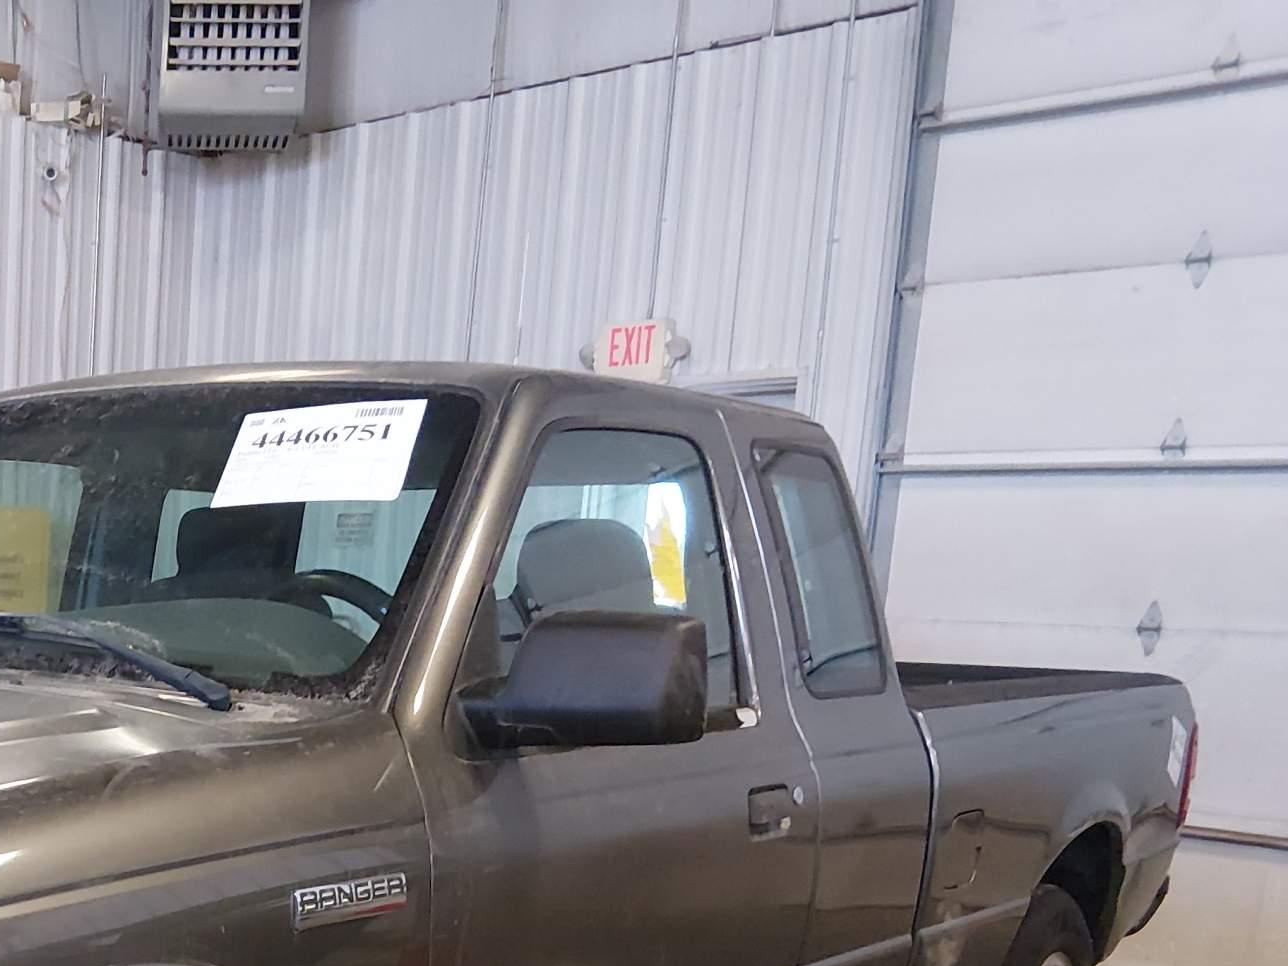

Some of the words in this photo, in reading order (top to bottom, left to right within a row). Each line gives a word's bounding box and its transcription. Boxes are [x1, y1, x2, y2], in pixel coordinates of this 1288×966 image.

[608, 325, 656, 367] EXIT
[251, 423, 392, 449] 44466751
[298, 876, 406, 914] RANGER
